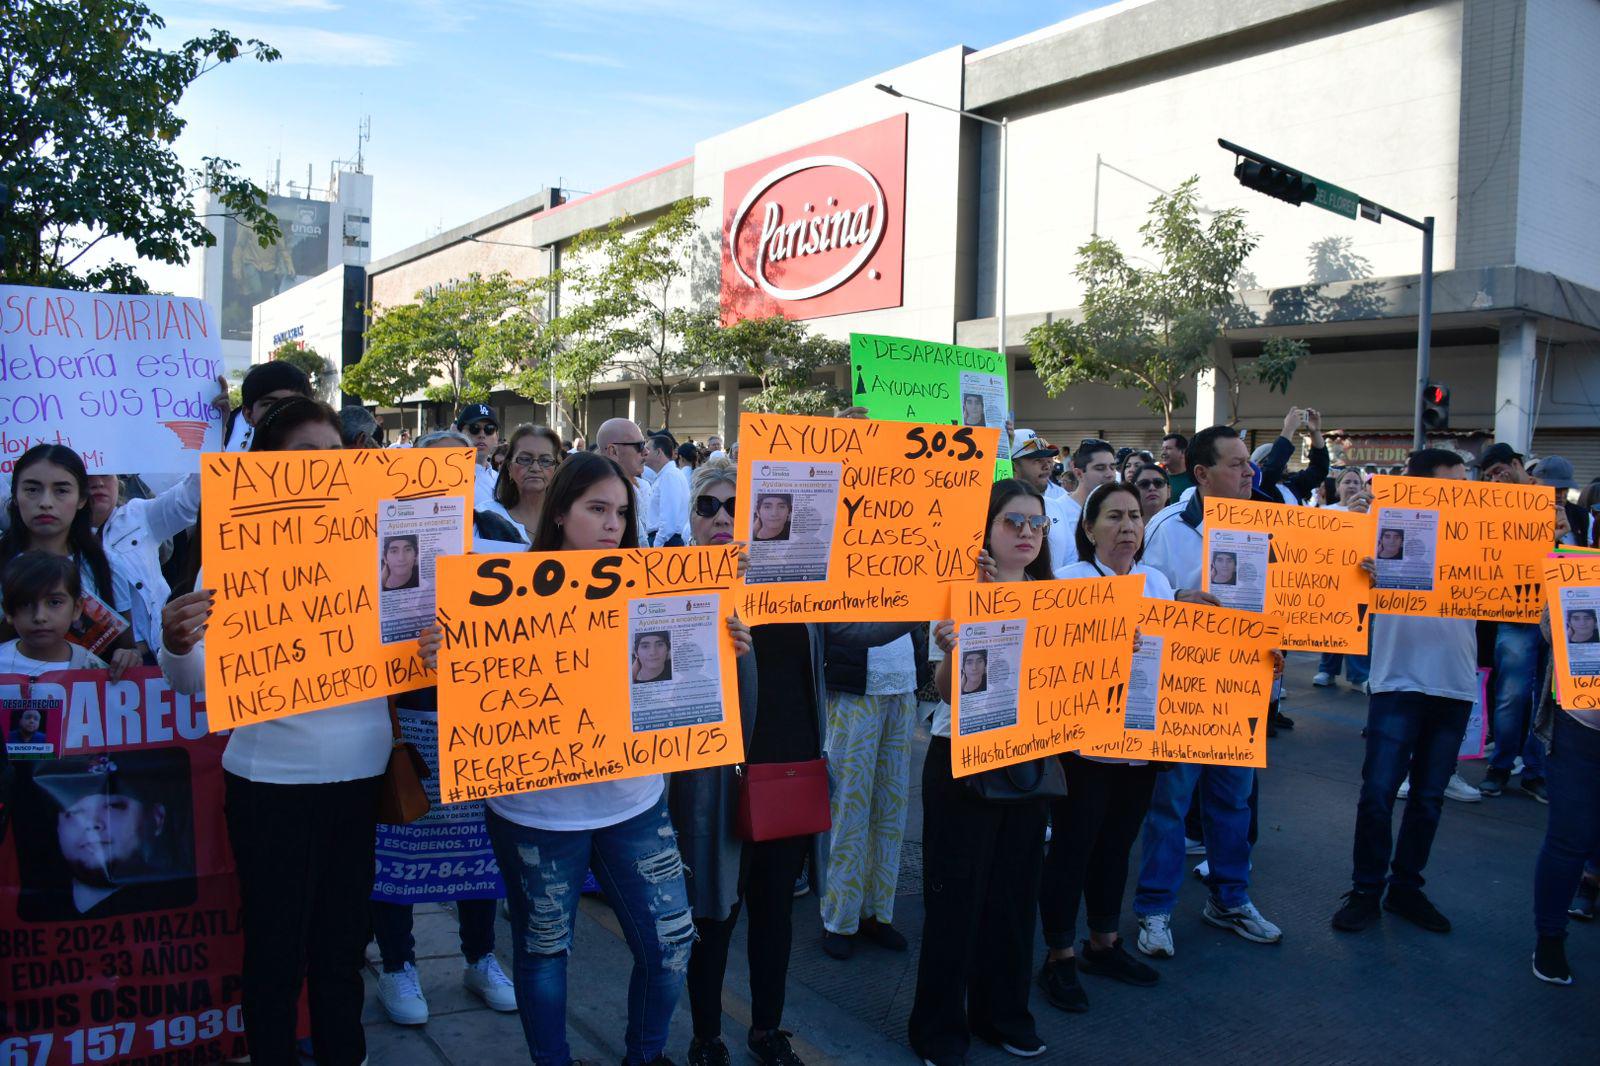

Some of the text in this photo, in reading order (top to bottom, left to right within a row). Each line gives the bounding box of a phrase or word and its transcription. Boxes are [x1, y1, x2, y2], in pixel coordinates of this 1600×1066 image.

[757, 196, 873, 264] Parisina
[0, 295, 208, 341] SCAR DARIAN
[137, 348, 220, 382] estar
[79, 388, 143, 417] SUS
[906, 404, 916, 418] A
[904, 426, 984, 461] S.O.S.
[1347, 446, 1410, 461] CATEDR
[924, 469, 982, 490] SEGUIR
[842, 495, 914, 527] YENDO
[928, 499, 943, 518] A
[219, 508, 378, 551] EN MI SALÓN
[1445, 520, 1469, 541] NO
[1479, 520, 1497, 540] TE
[1503, 520, 1554, 542] RINDAS
[846, 554, 929, 578] RECTOR
[1315, 548, 1336, 565] SE
[1342, 549, 1358, 566] LO
[1482, 546, 1502, 562] TU
[223, 561, 331, 600] HAY UNA
[468, 555, 635, 606] S.O.S.
[1271, 570, 1340, 591] LLEVARON
[1439, 565, 1503, 581] FAMILIA
[1514, 564, 1535, 580] TE
[223, 602, 293, 639] SILLA
[302, 584, 372, 623] VACIA
[968, 581, 1115, 617] INÉS ESCUCHA
[1275, 592, 1325, 608] VIVO LO
[1375, 592, 1427, 614] 16/01/25
[588, 609, 620, 631] ME
[1034, 616, 1127, 648] TU FAMILIA
[219, 638, 306, 687] FALTAS
[320, 624, 354, 657] TU
[451, 649, 589, 683] ESPERA EN
[1170, 641, 1261, 665] PORQUE UNA
[1028, 664, 1067, 691] ESTA
[1072, 660, 1094, 683] EN
[1101, 656, 1121, 681] LA
[1160, 672, 1261, 696] MADRE NUNCA
[228, 680, 286, 722] INÉS
[292, 664, 377, 710] ALBERTO
[480, 682, 564, 712] CASA
[1158, 698, 1228, 716] OLVIDA NI
[448, 714, 562, 752] AYUDAME
[577, 708, 596, 733] A
[623, 727, 728, 766] 16/01/25
[392, 824, 480, 838] INFORMACION
[468, 838, 482, 848] TU
[55, 920, 126, 954] 2024
[12, 941, 209, 992] EDAD: 33 AÑOS
[91, 978, 212, 1023] OSUNA
[64, 1022, 136, 1065] 157
